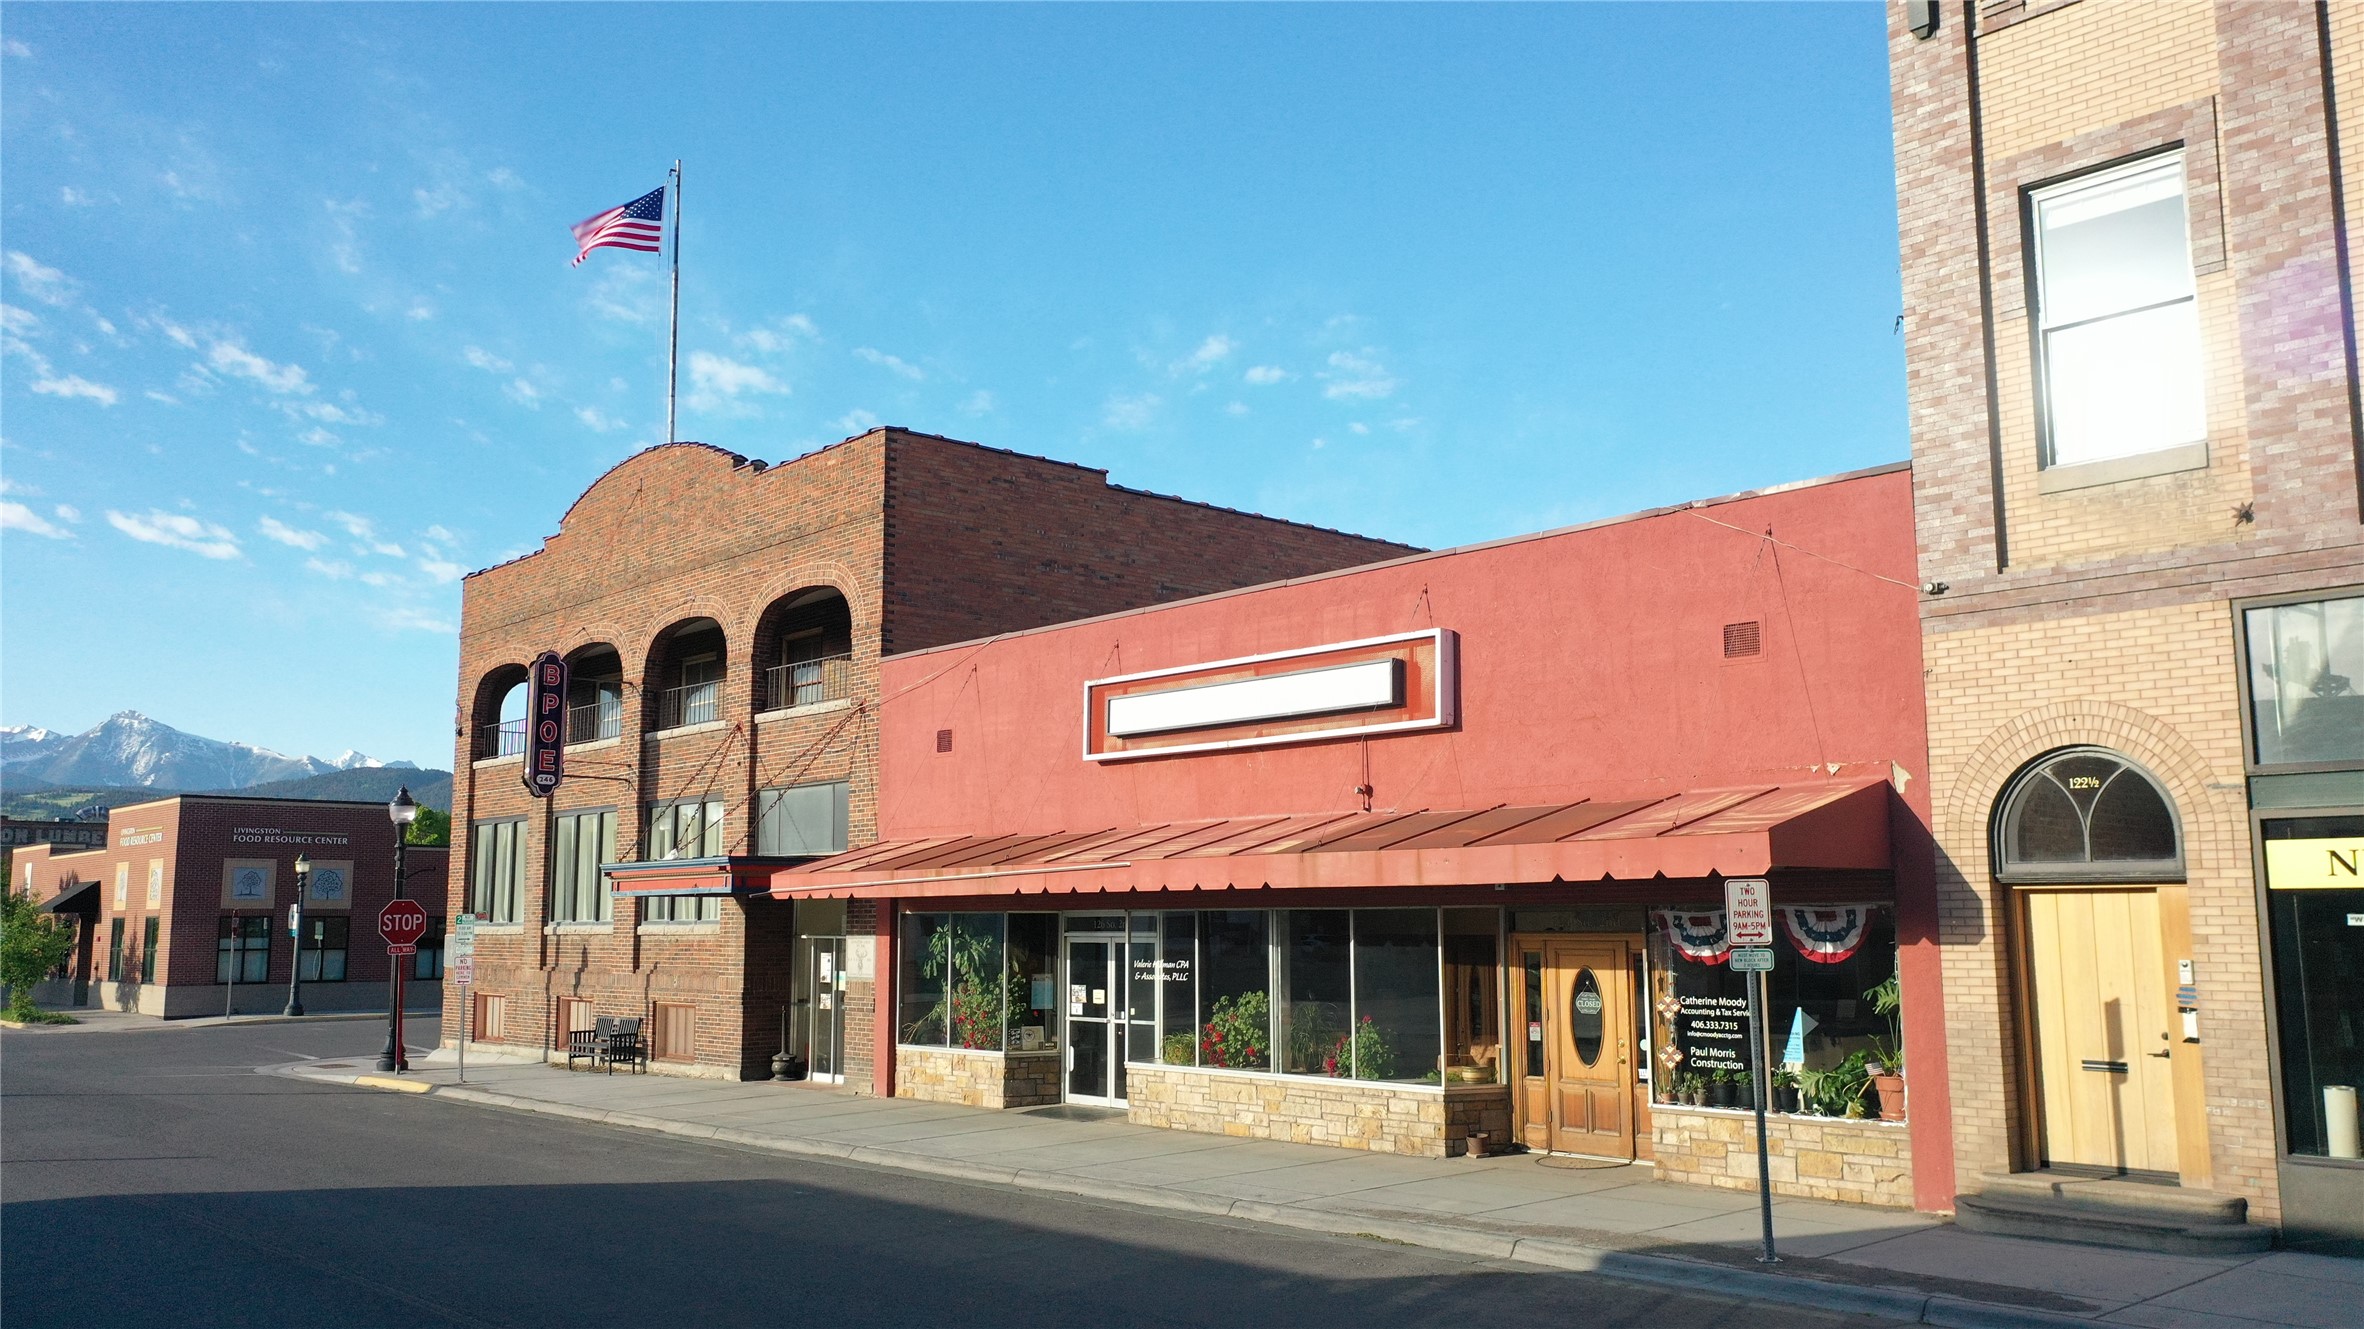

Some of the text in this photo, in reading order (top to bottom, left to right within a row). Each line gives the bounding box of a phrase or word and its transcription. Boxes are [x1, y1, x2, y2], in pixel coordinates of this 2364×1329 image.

[538, 664, 561, 772] BPOE
[36, 828, 107, 845] LUMBE
[233, 835, 348, 845] FOOD RESOURCE CENTER
[2326, 848, 2364, 877] N
[1739, 887, 1755, 896] TWO
[1737, 898, 1758, 907] HOUR
[1733, 910, 1764, 919] PARKING
[382, 914, 423, 932] STOP
[1732, 921, 1767, 931] 9AM-5PM
[1133, 958, 1152, 969] Valerie
[1176, 959, 1190, 970] CPA
[1134, 971, 1189, 982] & Assotes, PLLC
[1577, 1000, 1601, 1008] CLOSED
[1680, 995, 1747, 1009] Catherine Moody
[1680, 1007, 1715, 1017] Accounting
[1715, 1008, 1721, 1016] &
[1721, 1008, 1732, 1016] Tax
[1690, 1020, 1739, 1031] 406.333.7315
[1690, 1046, 1736, 1058] Paul Morris
[1690, 1057, 1744, 1070] Construction
